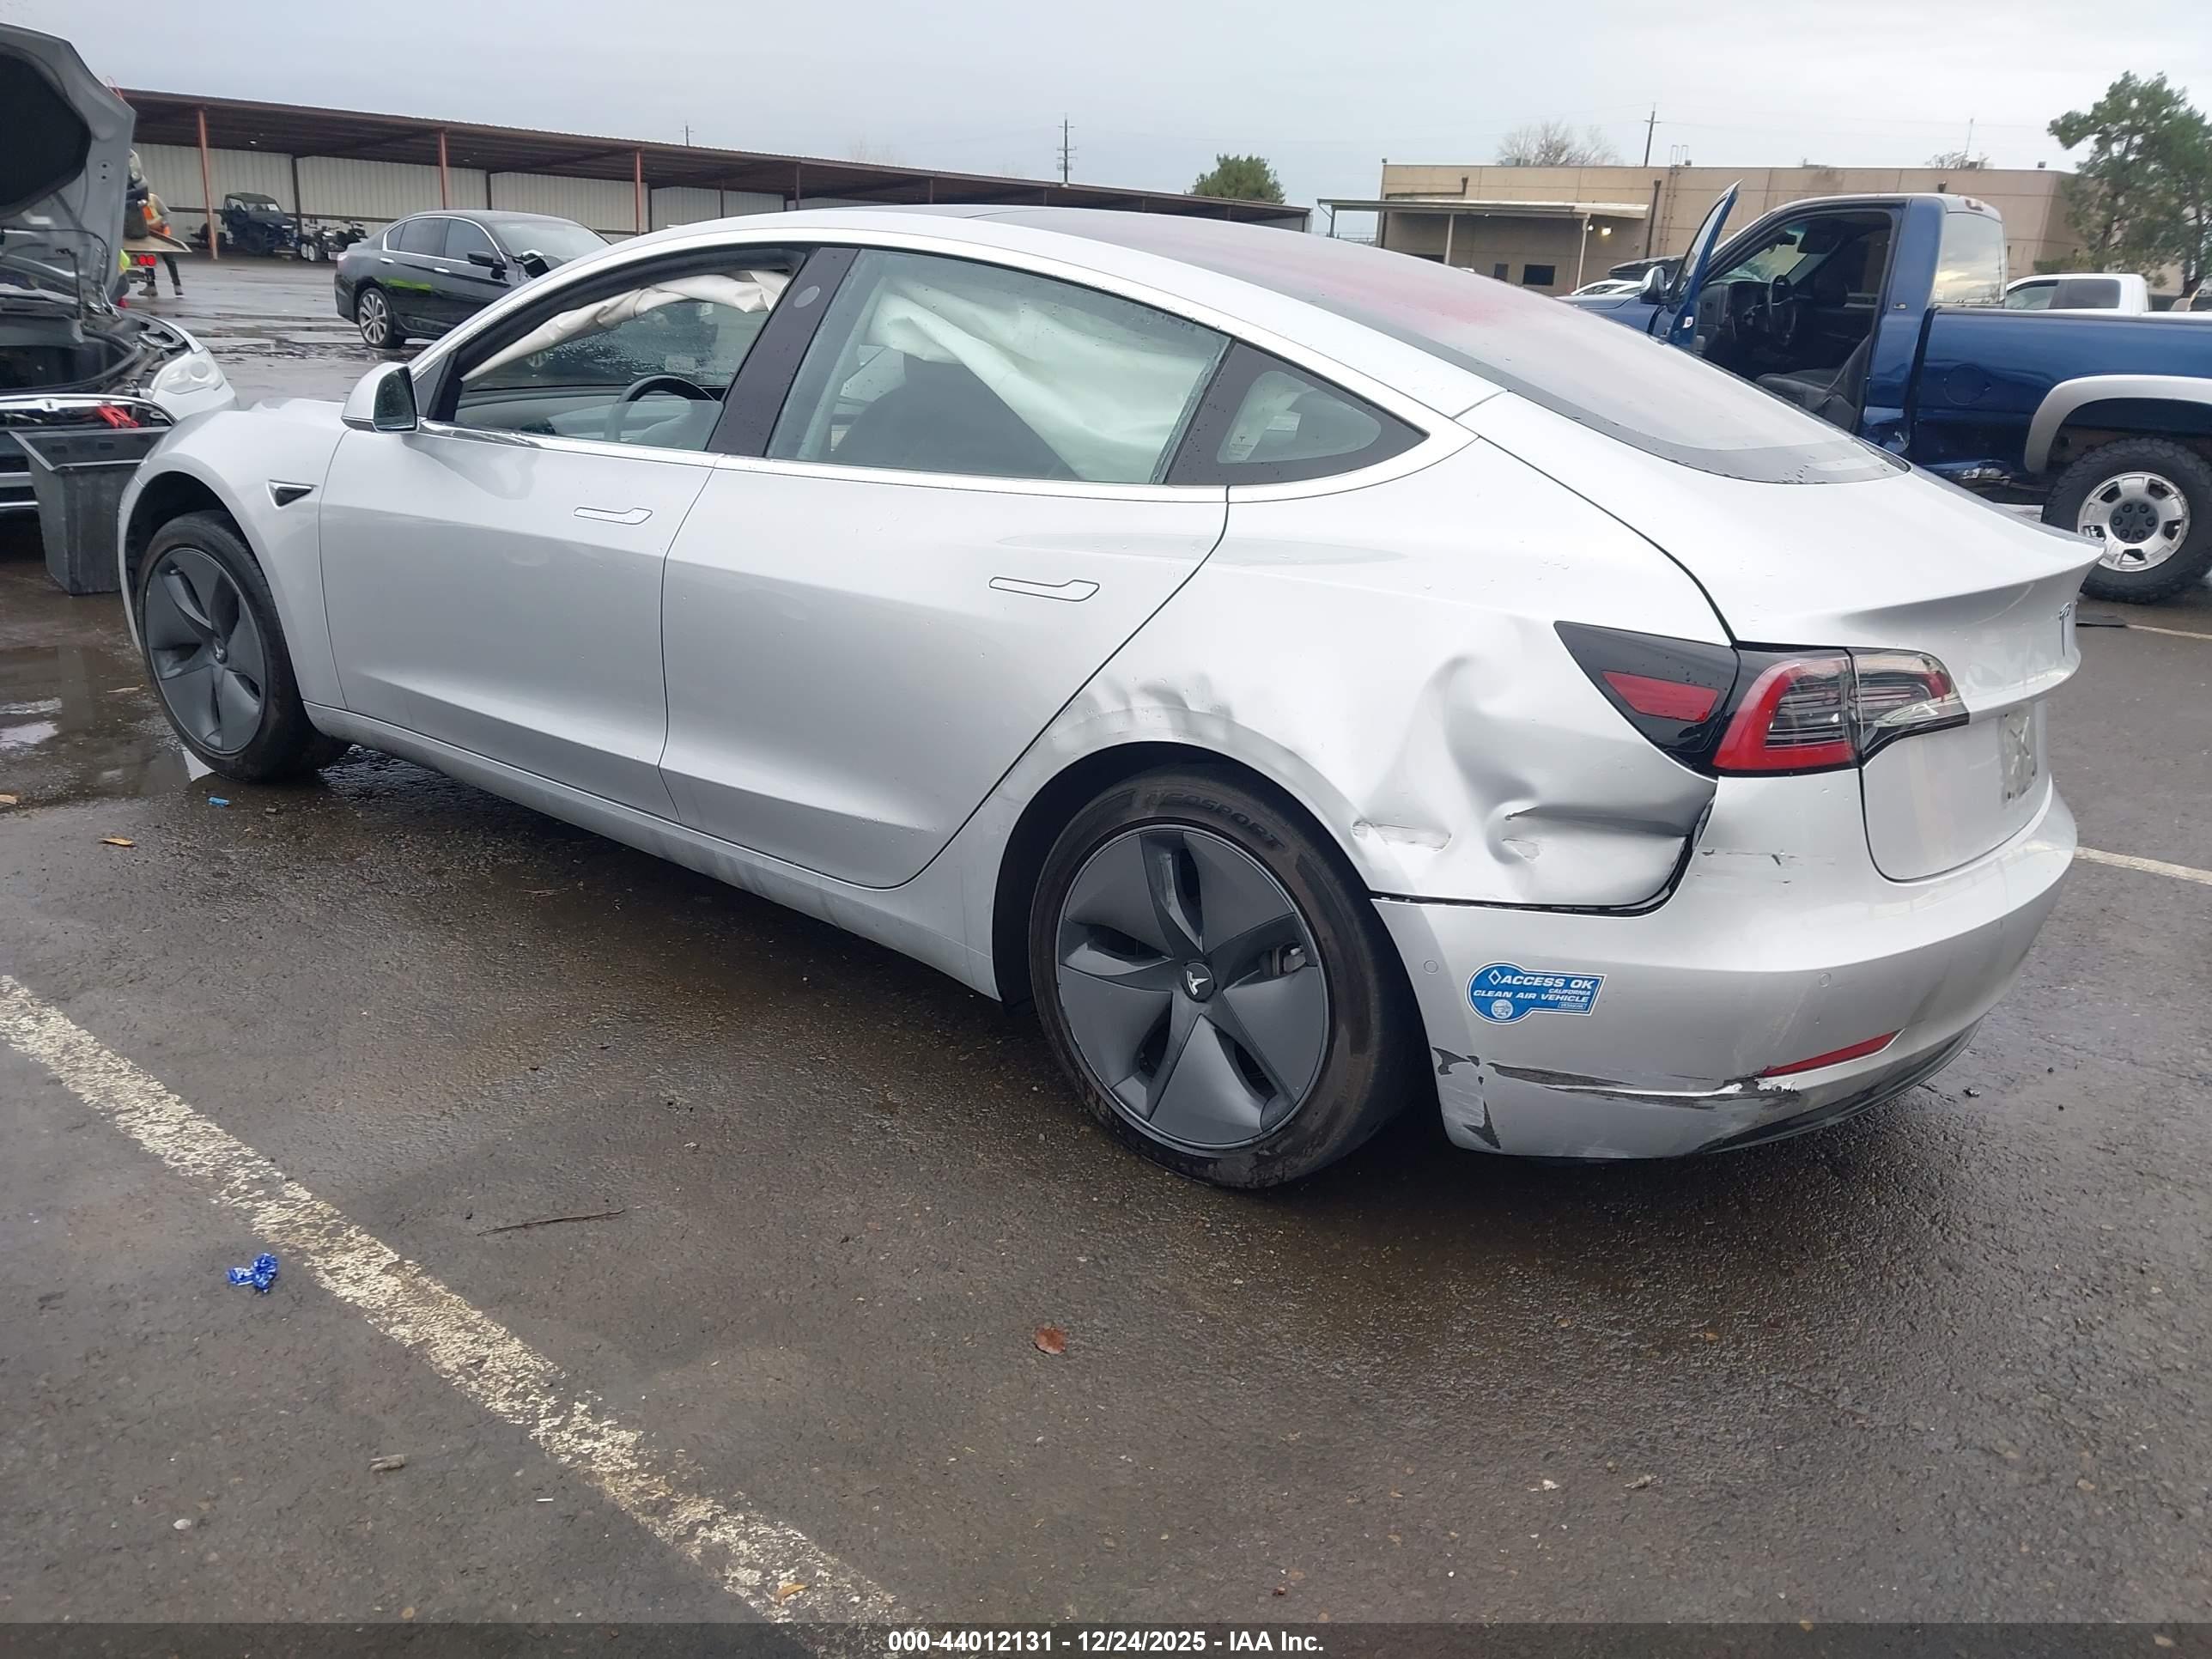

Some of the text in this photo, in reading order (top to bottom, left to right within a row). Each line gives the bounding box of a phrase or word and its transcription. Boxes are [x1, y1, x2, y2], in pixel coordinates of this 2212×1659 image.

[1500, 975, 1595, 989] ACCESS OK
[1473, 989, 1513, 998] CLEAN
[1540, 994, 1590, 1002] VEHICLE
